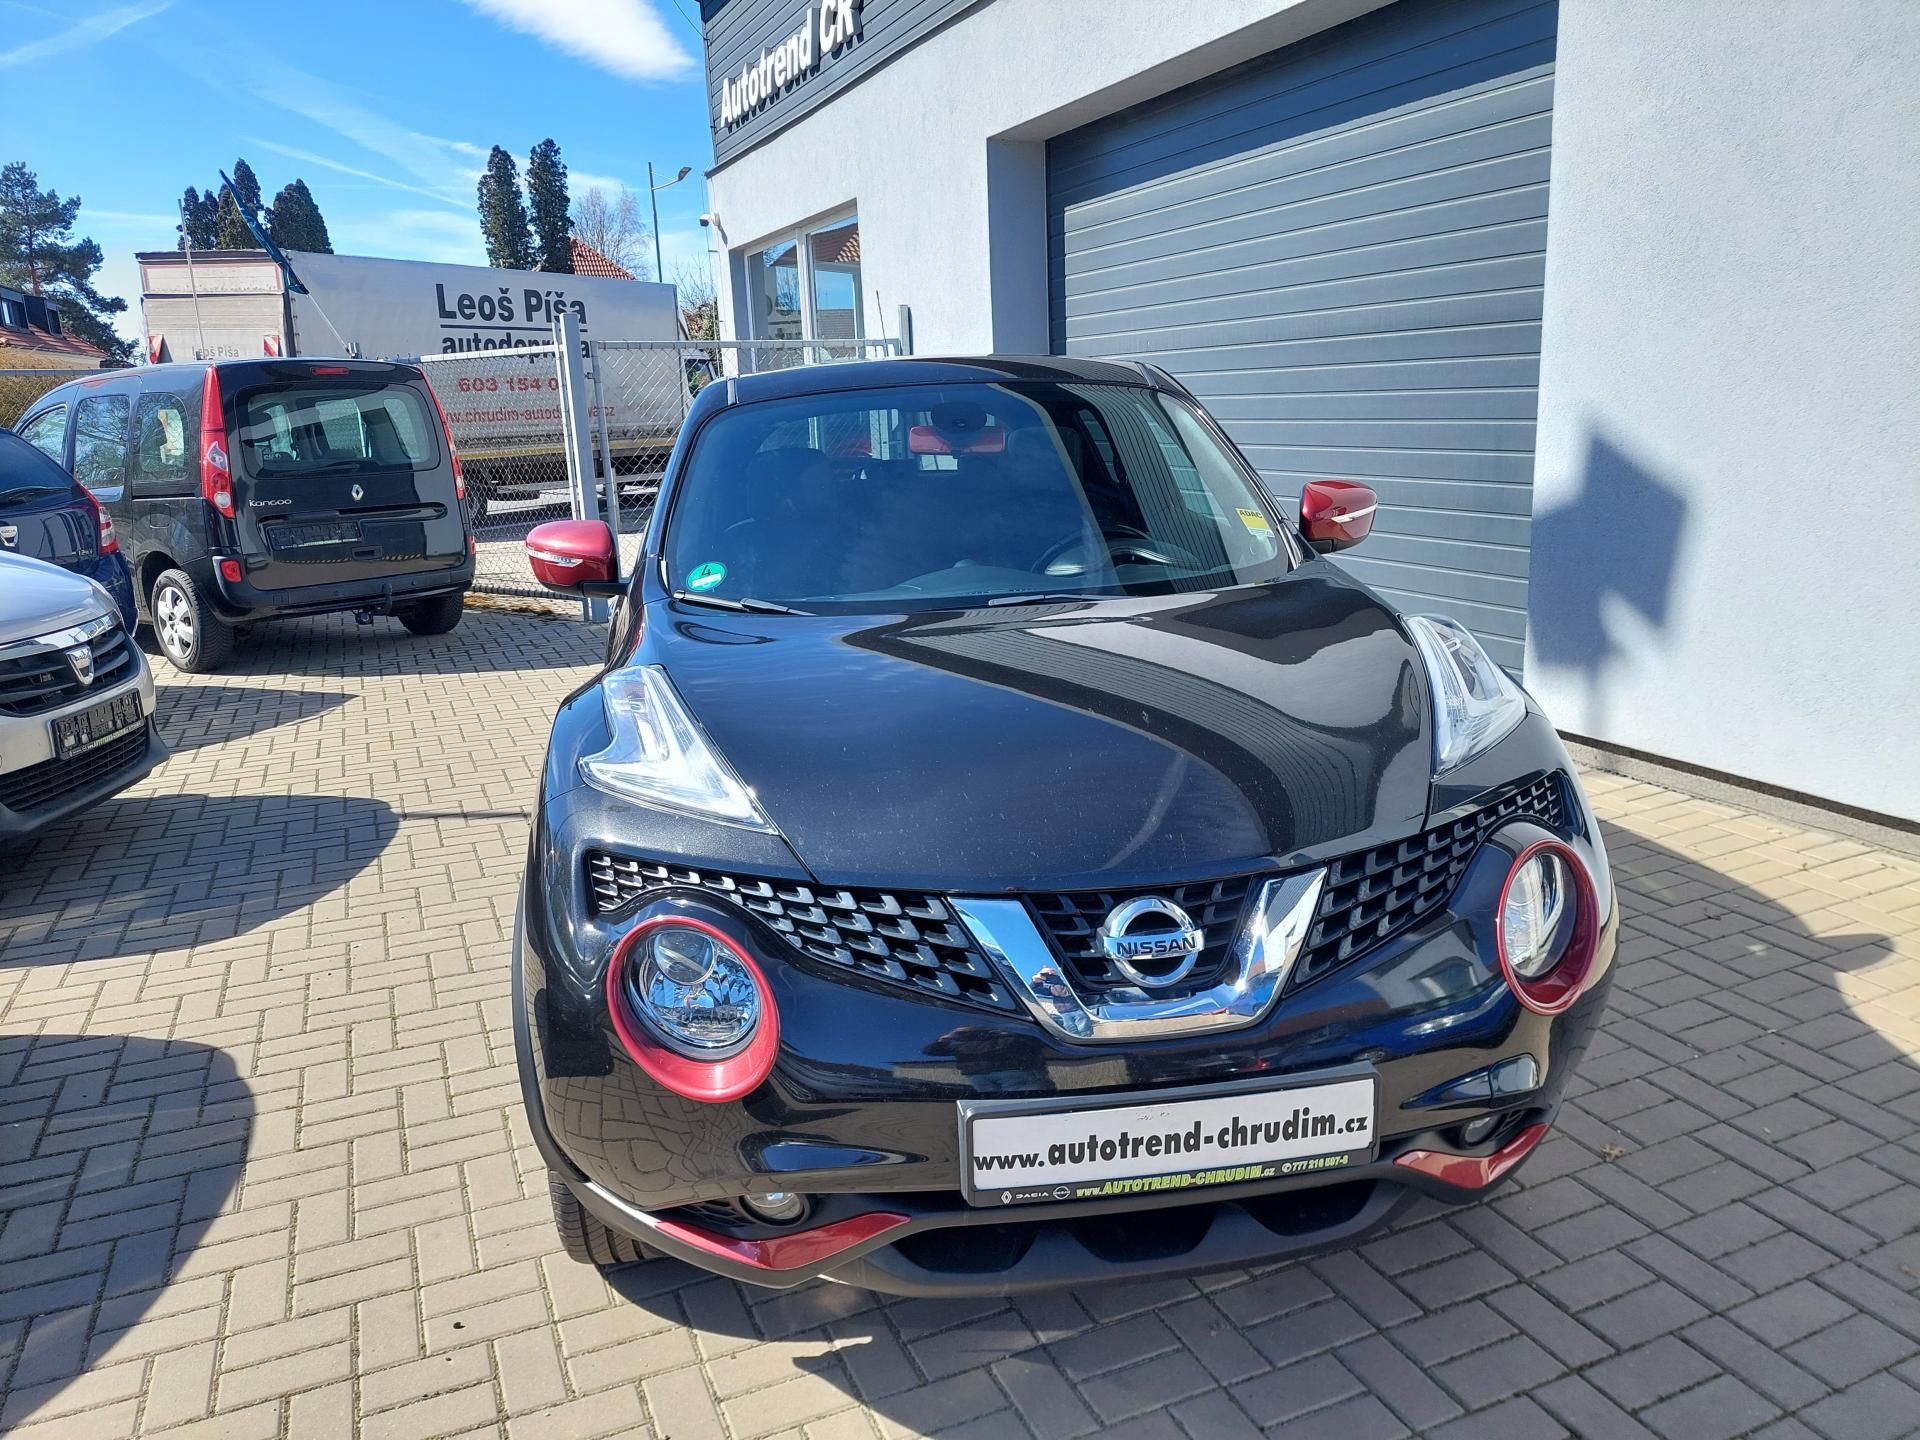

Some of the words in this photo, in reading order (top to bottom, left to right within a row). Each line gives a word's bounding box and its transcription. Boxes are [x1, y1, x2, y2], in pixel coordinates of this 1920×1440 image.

[720, 8, 814, 128] Autotrend
[436, 283, 515, 322] Leoš
[523, 288, 588, 325] Píša
[458, 377, 498, 392] 603
[506, 377, 543, 392] 154
[1239, 509, 1263, 519] ADAC
[701, 564, 712, 576] 4
[1116, 936, 1196, 956] NISSAN
[973, 1107, 1368, 1171] www.autotrend-chrudim.cz
